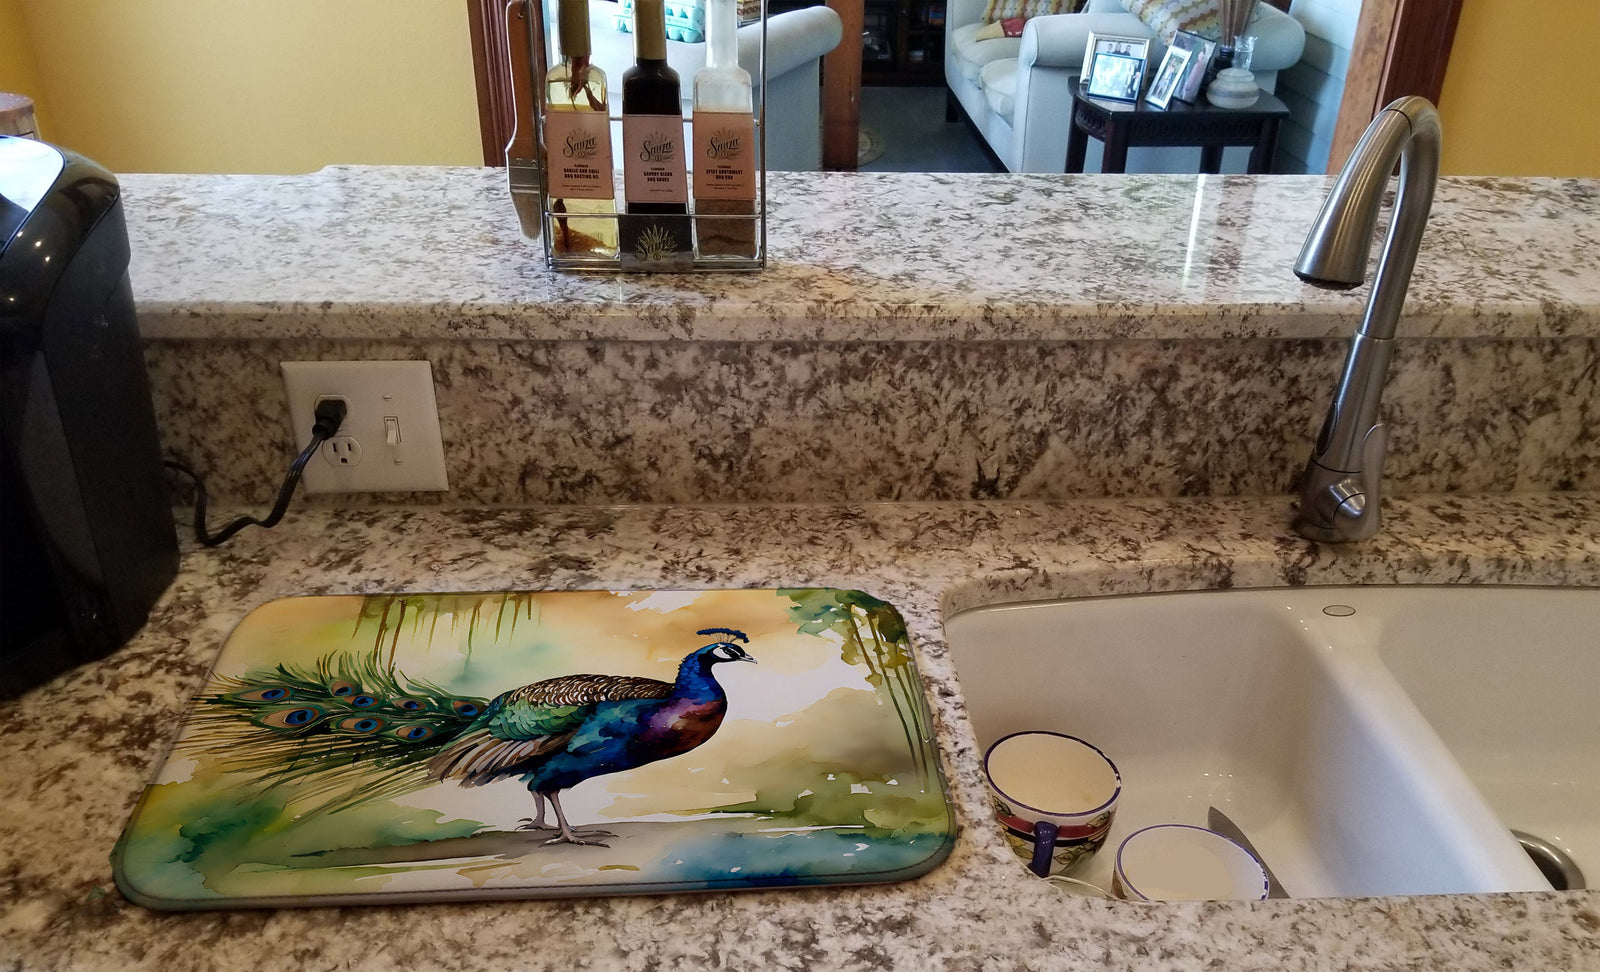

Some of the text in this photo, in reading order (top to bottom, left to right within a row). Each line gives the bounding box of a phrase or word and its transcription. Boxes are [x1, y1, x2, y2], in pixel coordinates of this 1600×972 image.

[563, 136, 597, 158] Sauza
[640, 139, 673, 161] Sauza
[707, 136, 740, 159] Sauza
